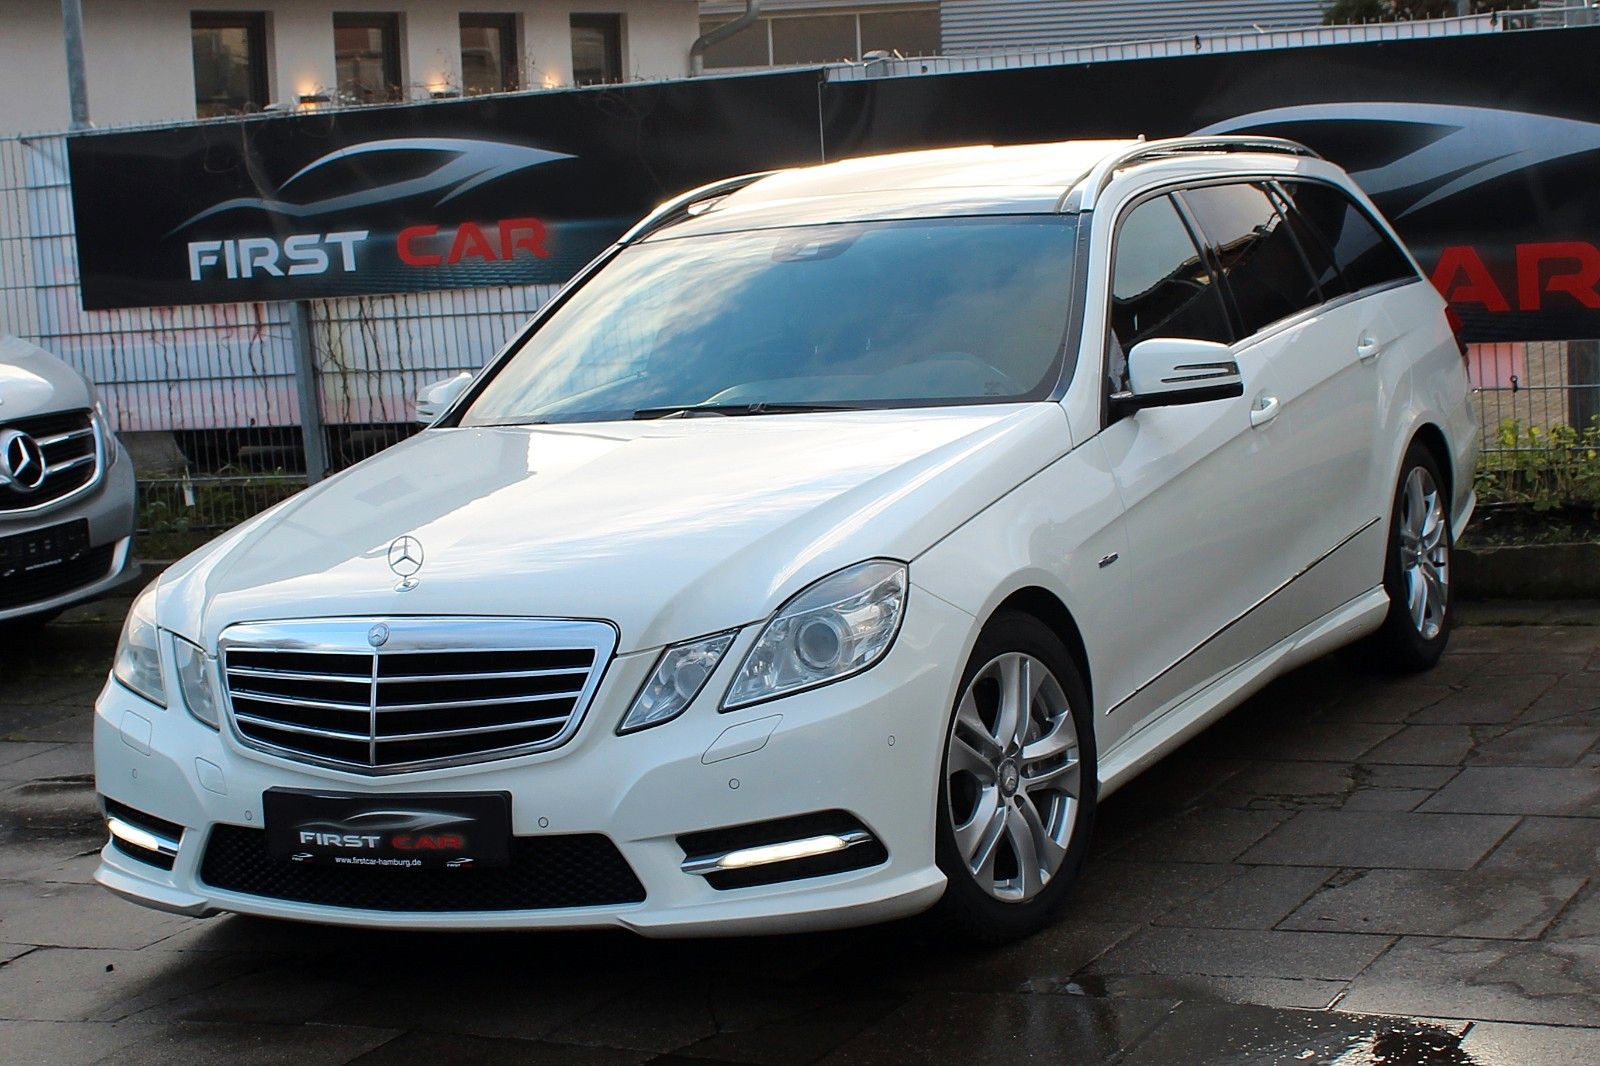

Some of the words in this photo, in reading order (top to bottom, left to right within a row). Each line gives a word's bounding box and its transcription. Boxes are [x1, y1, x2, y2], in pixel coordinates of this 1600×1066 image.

[187, 230, 369, 281] FIRST
[396, 217, 551, 266] CAR
[1430, 241, 1600, 312] AR
[299, 831, 381, 848] FIRST
[391, 834, 463, 849] CAR
[335, 856, 422, 867] www.firstcar-hamburg.de
